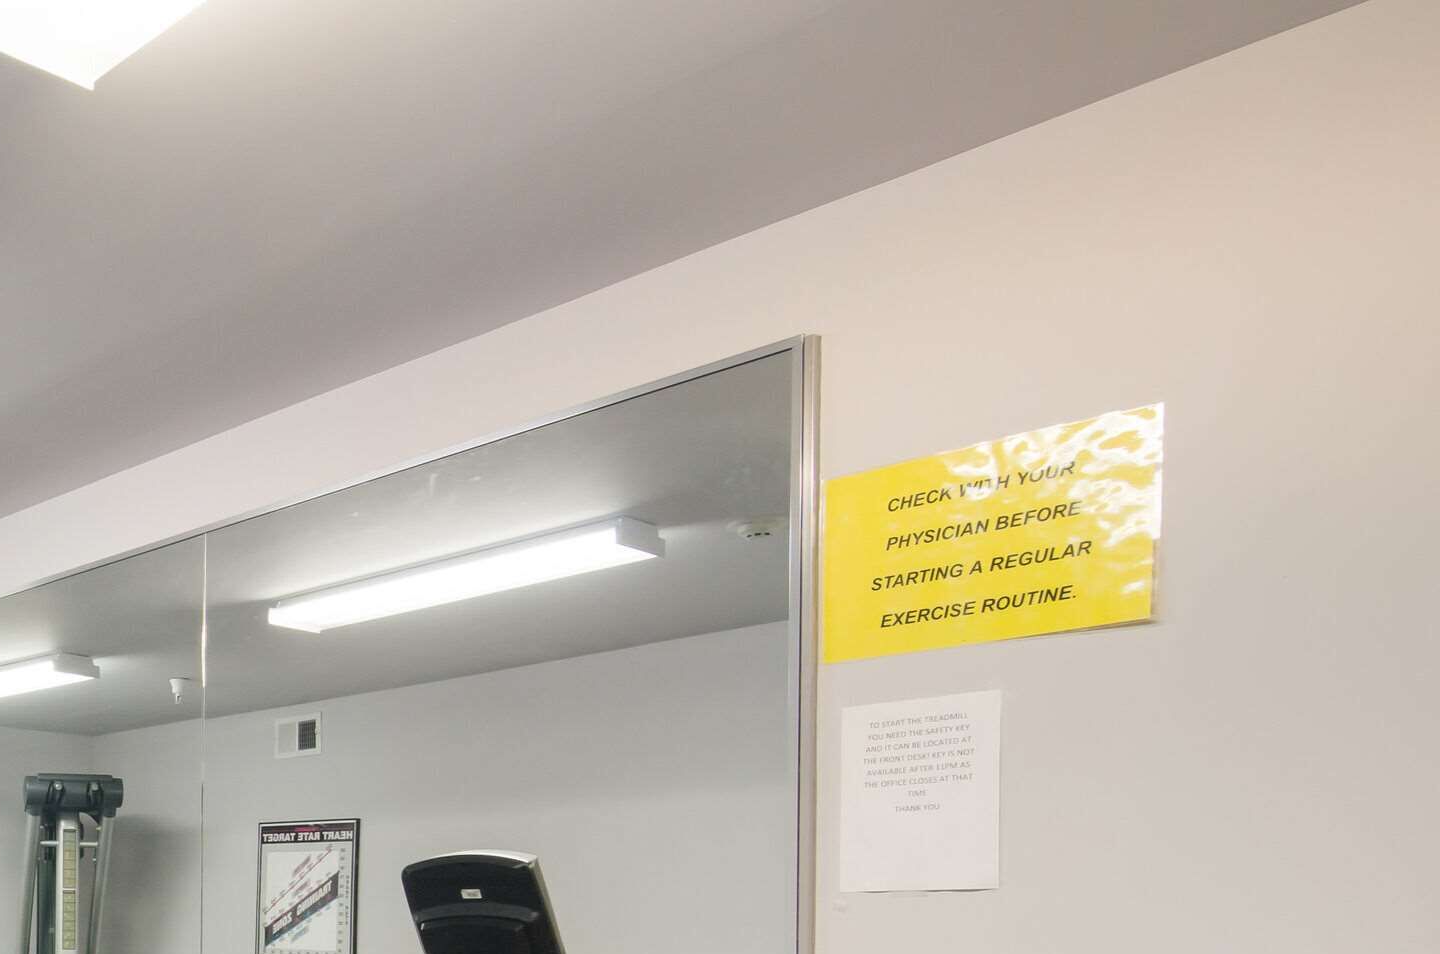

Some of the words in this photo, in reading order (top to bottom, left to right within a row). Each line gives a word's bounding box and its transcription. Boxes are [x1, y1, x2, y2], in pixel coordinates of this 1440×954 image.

[887, 488, 952, 513] CHECK
[959, 474, 1009, 497] WITH
[1017, 461, 1076, 484] YOUR
[886, 519, 989, 551] PHYSICIAN
[995, 500, 1082, 530] BEFORE
[871, 563, 963, 591] STARTING
[969, 560, 983, 576] A
[989, 540, 1092, 572] REGULAR
[880, 601, 975, 628] EXERCISE
[981, 584, 1077, 614] ROUTINE.
[882, 719, 905, 728] START
[908, 717, 922, 725] THE
[886, 731, 906, 740] NEED
[866, 745, 882, 753] AND
[893, 743, 910, 751] CAN
[961, 736, 972, 744] AT
[957, 748, 975, 757] NOT
[952, 773, 973, 782] THAT
[895, 805, 921, 813] THANK
